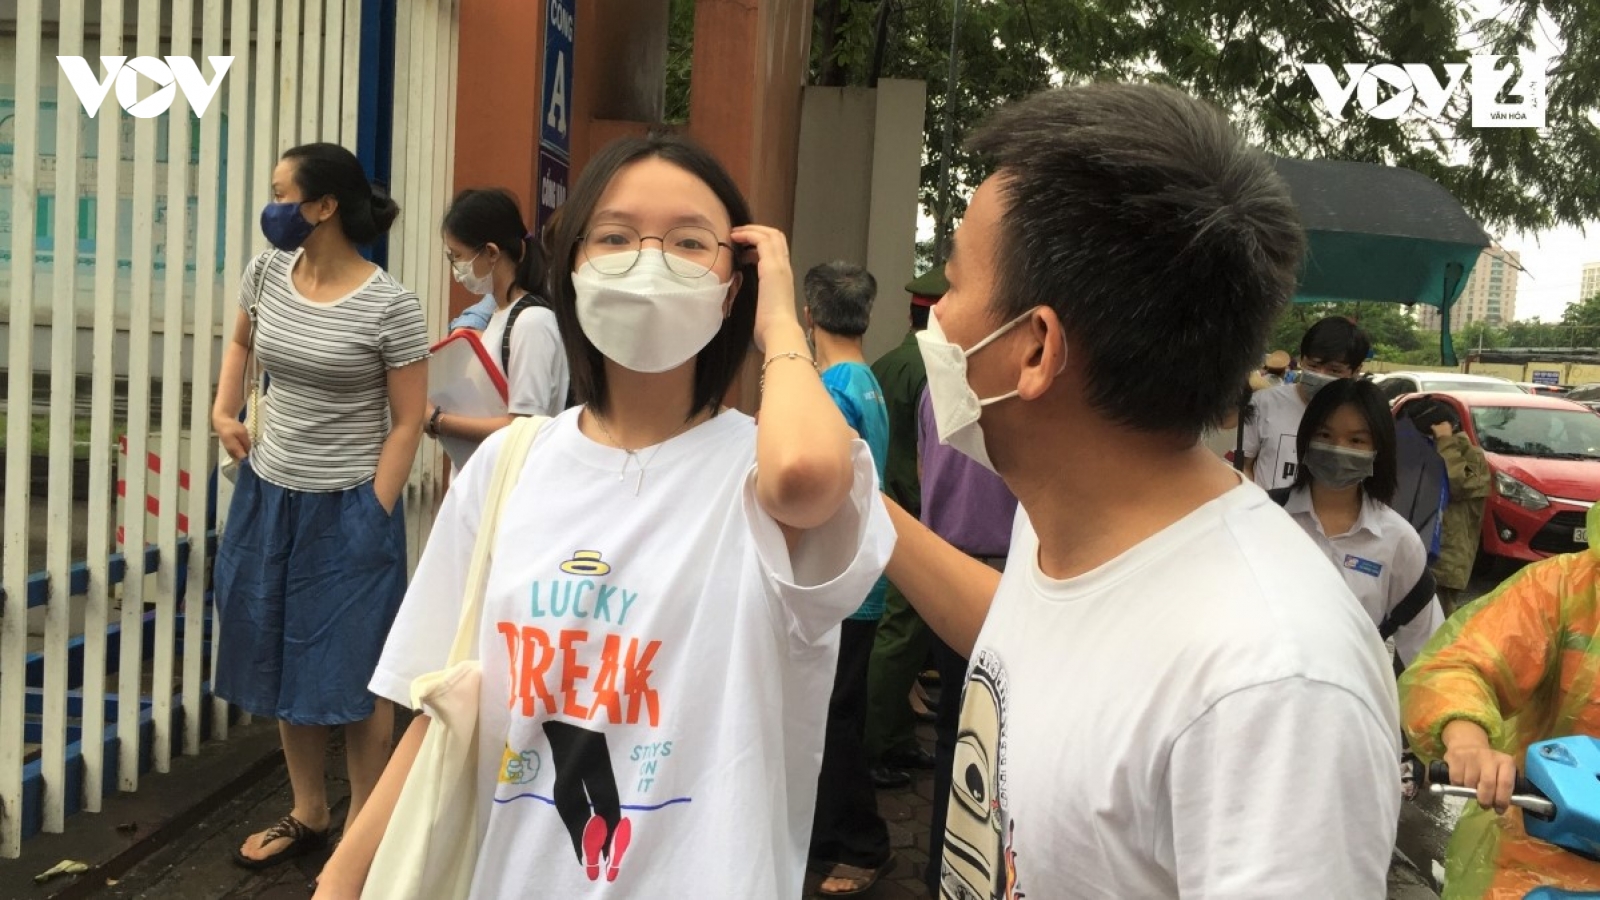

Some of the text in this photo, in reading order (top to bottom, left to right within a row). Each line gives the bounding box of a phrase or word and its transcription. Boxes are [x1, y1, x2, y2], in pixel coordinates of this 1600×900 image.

[547, 50, 567, 140] A
[530, 578, 638, 625] LUCKY
[637, 777, 655, 793] IT
